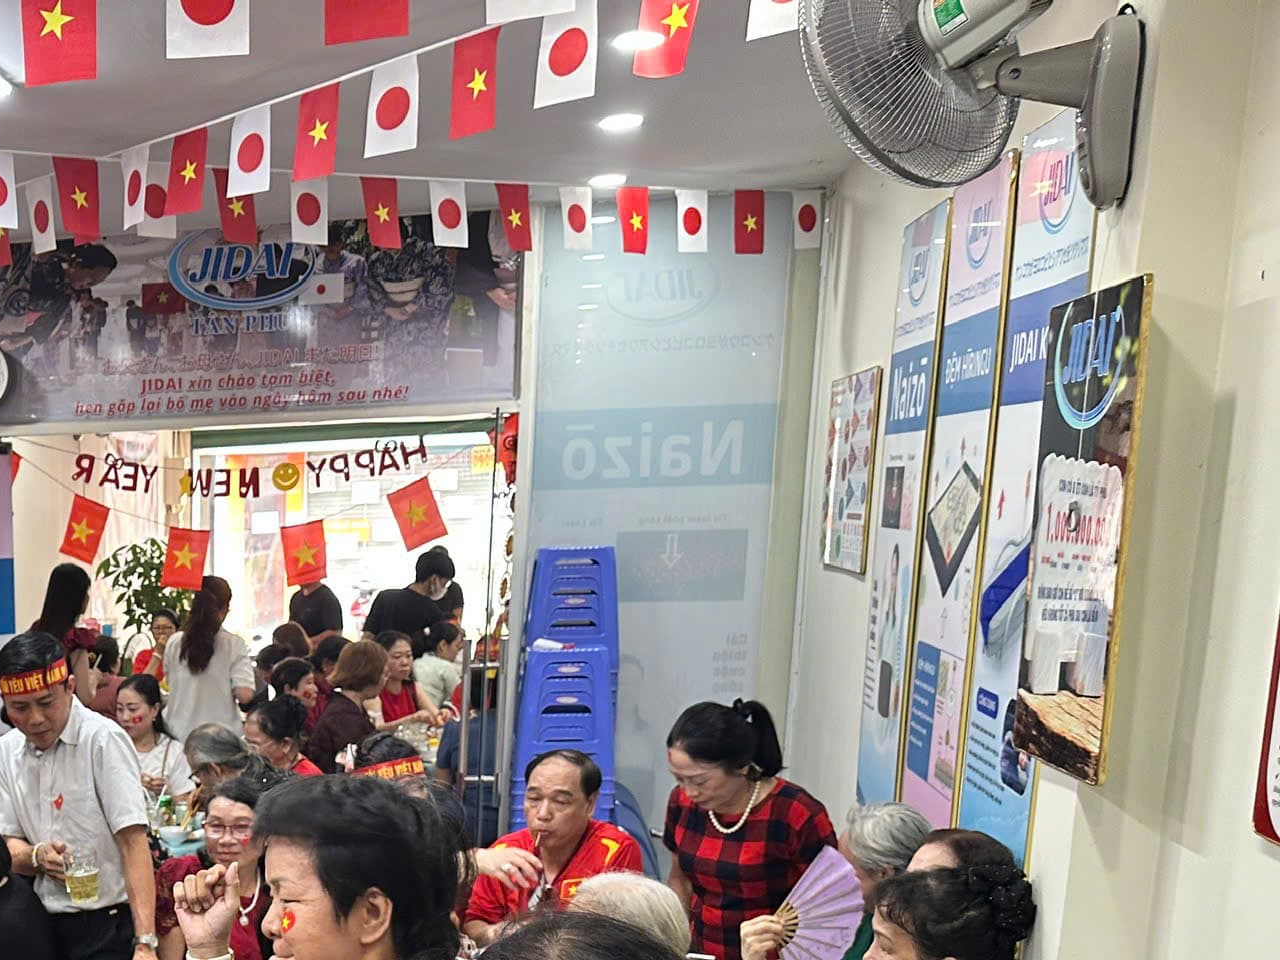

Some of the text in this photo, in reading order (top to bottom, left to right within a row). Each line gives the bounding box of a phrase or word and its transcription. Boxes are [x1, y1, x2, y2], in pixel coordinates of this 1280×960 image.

[189, 242, 295, 283] JIDAI
[192, 311, 237, 337] TÂN
[1009, 329, 1038, 373] JIDAI
[1060, 312, 1122, 385] JIDAI
[141, 377, 182, 395] JIDAI
[188, 377, 212, 390] xin
[218, 371, 255, 388] chào
[220, 393, 247, 408] vào
[337, 388, 367, 403] sau
[372, 385, 410, 401] nhé!
[890, 357, 929, 421] Naizō
